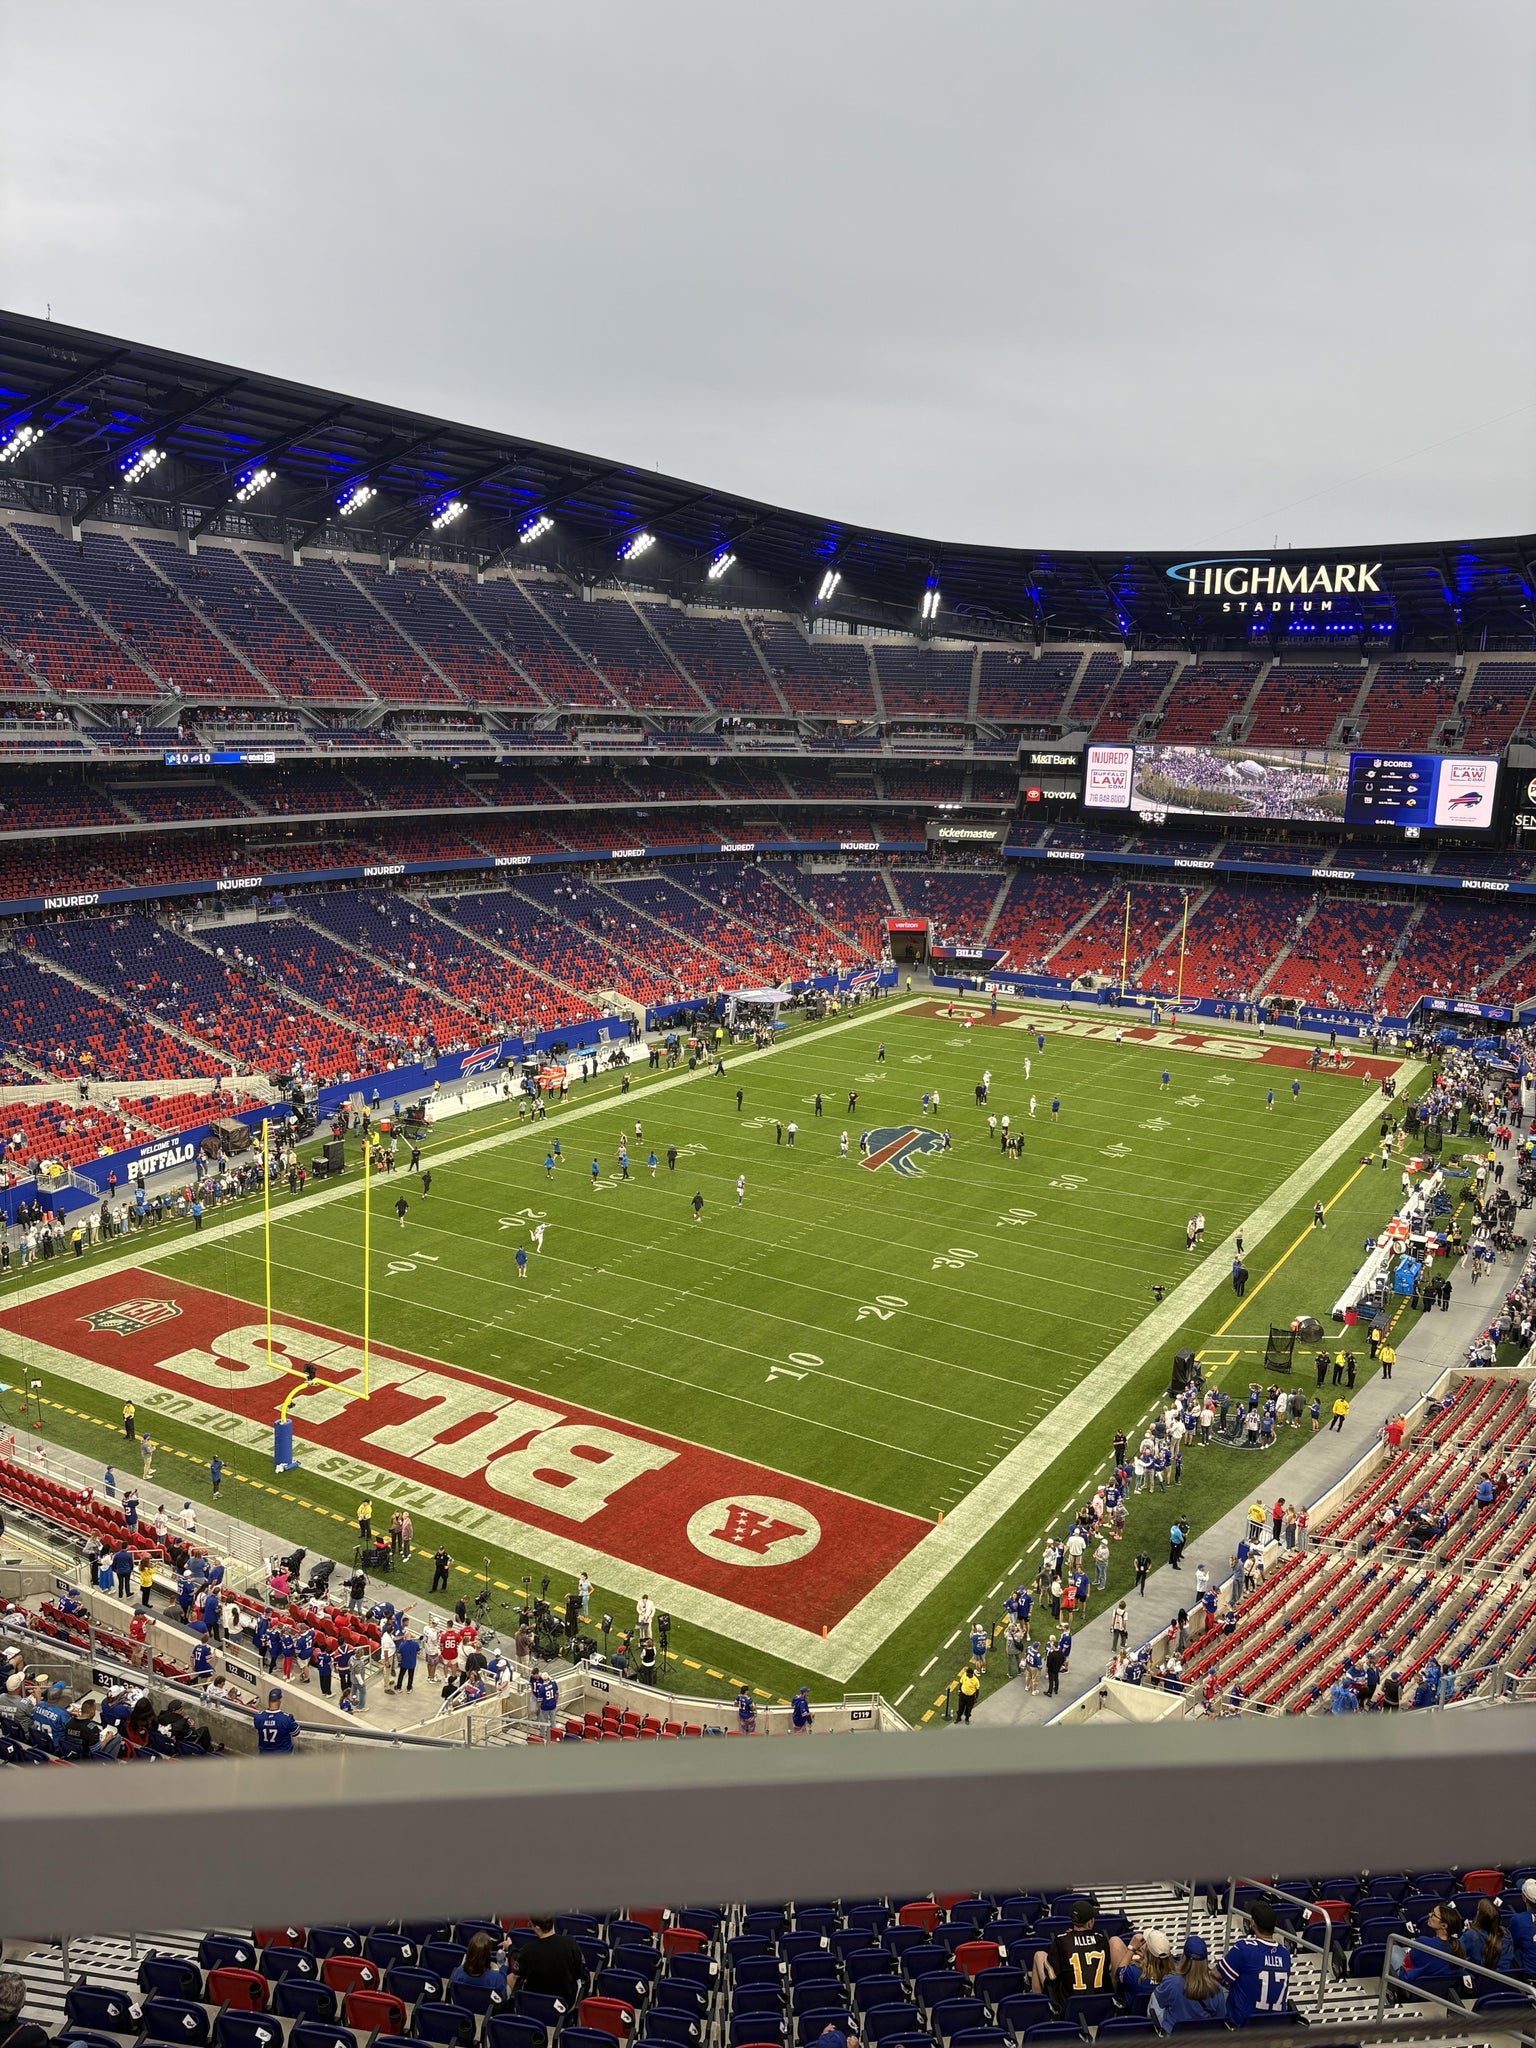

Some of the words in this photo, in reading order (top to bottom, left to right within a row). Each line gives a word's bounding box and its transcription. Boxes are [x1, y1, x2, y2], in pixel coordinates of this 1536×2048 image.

[1188, 563, 1382, 595] HIGHMARK
[1222, 601, 1333, 612] STADIUM
[1031, 754, 1053, 765] M&T
[1054, 755, 1076, 765] Bank
[1091, 751, 1129, 765] INJURED?
[1383, 760, 1413, 768] SCORES
[1093, 776, 1125, 785] LAW
[1453, 770, 1484, 778] LAW
[1043, 791, 1077, 799] TOYOTA
[939, 828, 997, 839] ticketmaster
[612, 848, 646, 858] INJURED?
[721, 843, 755, 852] INJURED?
[840, 842, 880, 851] INJURED?
[495, 856, 531, 867] INJURED?
[1047, 851, 1085, 860] INJURED?
[1174, 859, 1215, 869] INJURED?
[364, 865, 405, 877] INJURED?
[1312, 869, 1355, 880] INJURED?
[216, 877, 263, 891] INJURED?
[1462, 880, 1509, 892] INJURED?
[44, 893, 100, 910] INJURED?
[956, 949, 983, 958] BILLS
[1000, 1014, 1271, 1060] BILLS
[140, 1141, 170, 1156] WELCOME
[171, 1137, 179, 1146] TO
[127, 1143, 194, 1180] BUFFALO
[1049, 1174, 1089, 1190] 50
[999, 1208, 1038, 1226] 40
[932, 1247, 979, 1270] 30
[112, 1300, 174, 1324] NFL
[858, 1294, 909, 1321] 20
[769, 1352, 825, 1382] 10
[143, 1392, 195, 1420] US
[153, 1324, 682, 1523] BILLS
[193, 1412, 243, 1432] OF
[316, 1456, 437, 1510] TAKES
[442, 1506, 494, 1530] IT
[58, 1580, 67, 1590] 122
[228, 1663, 238, 1674] 122
[243, 1671, 254, 1682] 121
[98, 1673, 113, 1686] 321
[592, 1680, 608, 1691] C119
[852, 1711, 870, 1719] C119
[262, 1728, 278, 1743] 17
[1074, 1935, 1097, 1946] ALLEN
[1264, 1955, 1283, 1967] ALLEN
[1068, 1950, 1105, 1990] 17
[1255, 1970, 1288, 2011] 17
